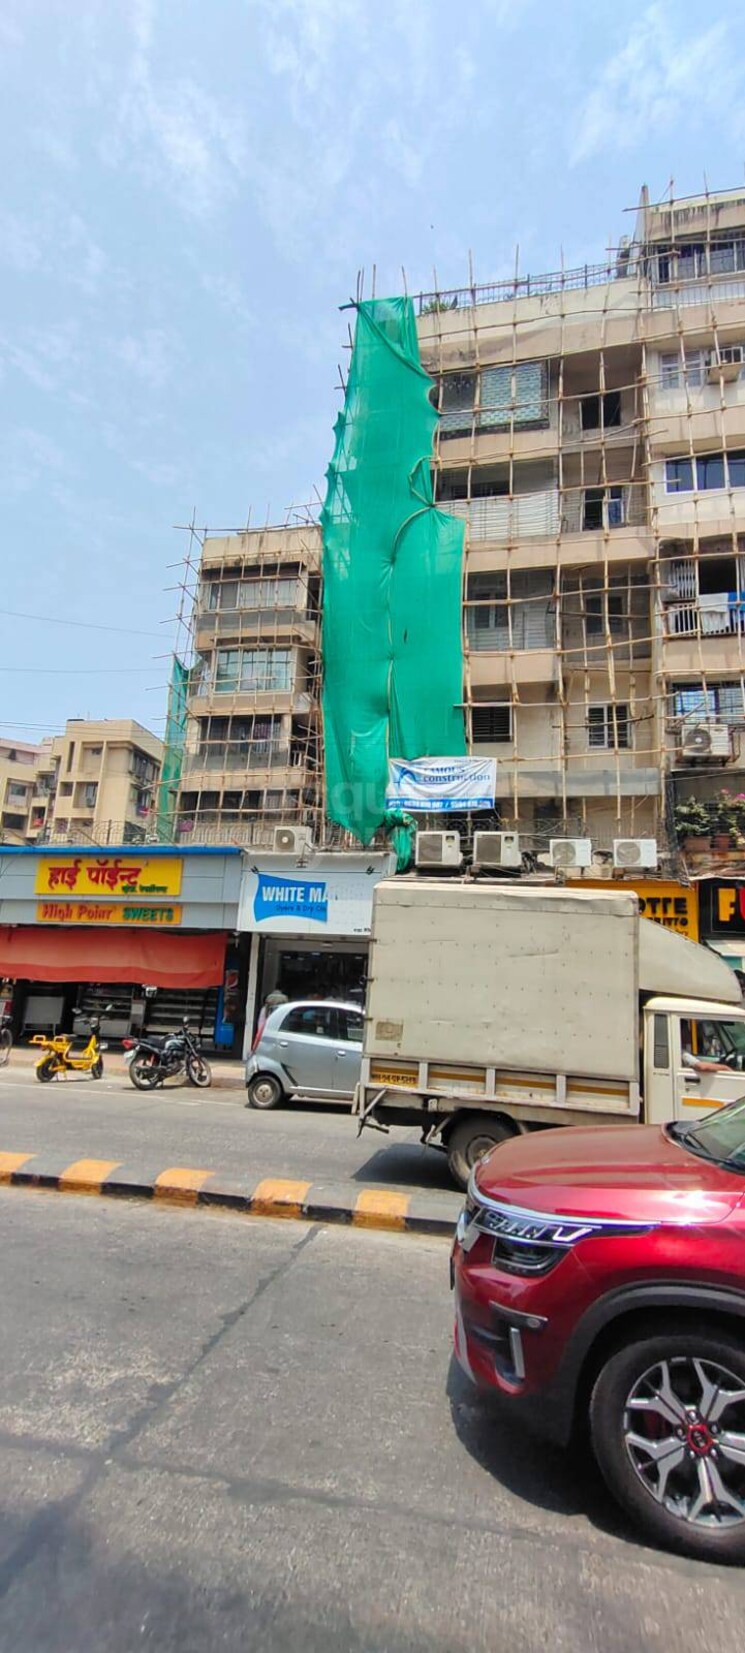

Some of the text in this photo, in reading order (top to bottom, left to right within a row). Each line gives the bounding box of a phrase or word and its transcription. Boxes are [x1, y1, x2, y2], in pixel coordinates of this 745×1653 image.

[48, 859, 82, 890] हाई
[262, 886, 305, 903] WHITE
[42, 903, 174, 922] High Point SWEETS
